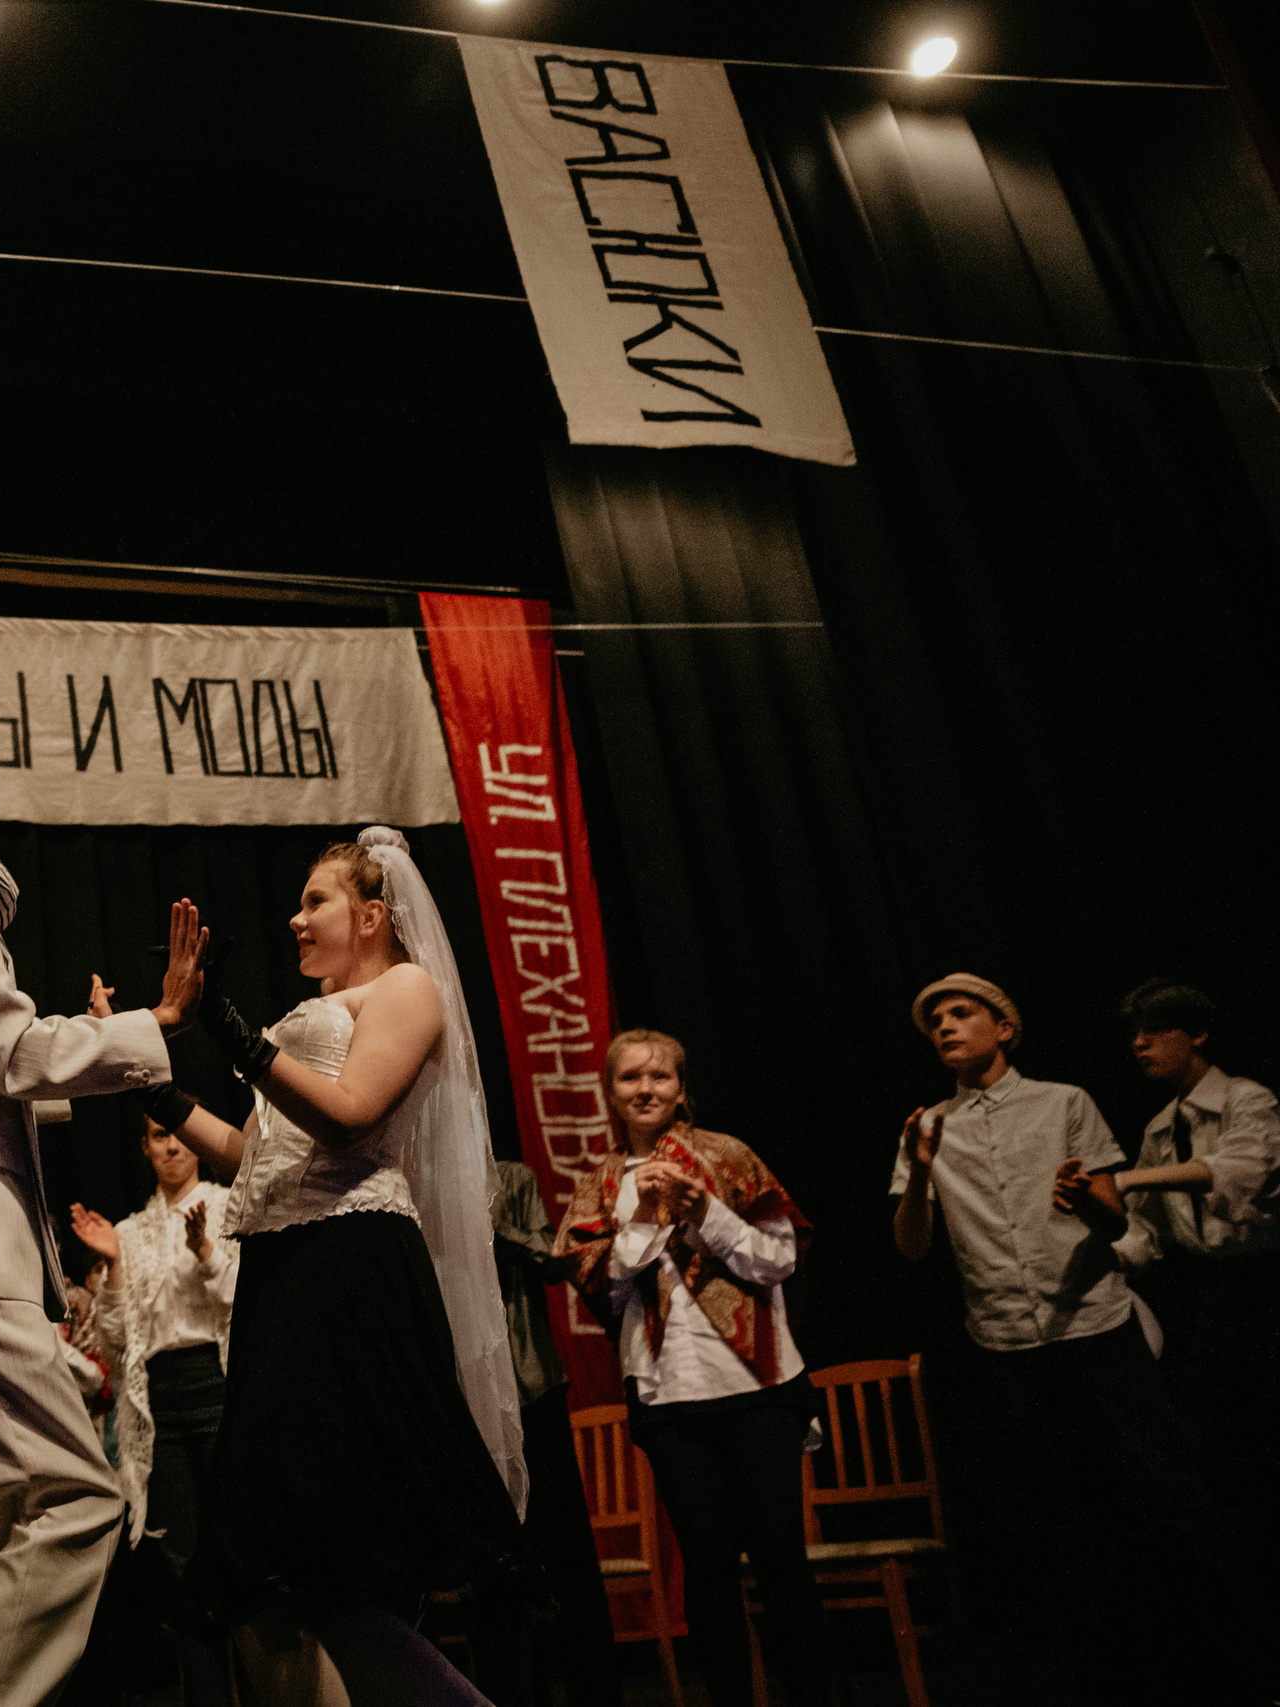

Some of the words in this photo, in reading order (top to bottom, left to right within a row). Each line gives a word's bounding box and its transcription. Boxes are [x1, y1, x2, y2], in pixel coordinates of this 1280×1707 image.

[533, 54, 764, 429] ВАСЮКИ
[66, 673, 124, 774] И
[151, 676, 339, 780] МОДЫ
[478, 741, 558, 827] УЛ.
[494, 847, 615, 1203] ПЛЕХАНОВ
